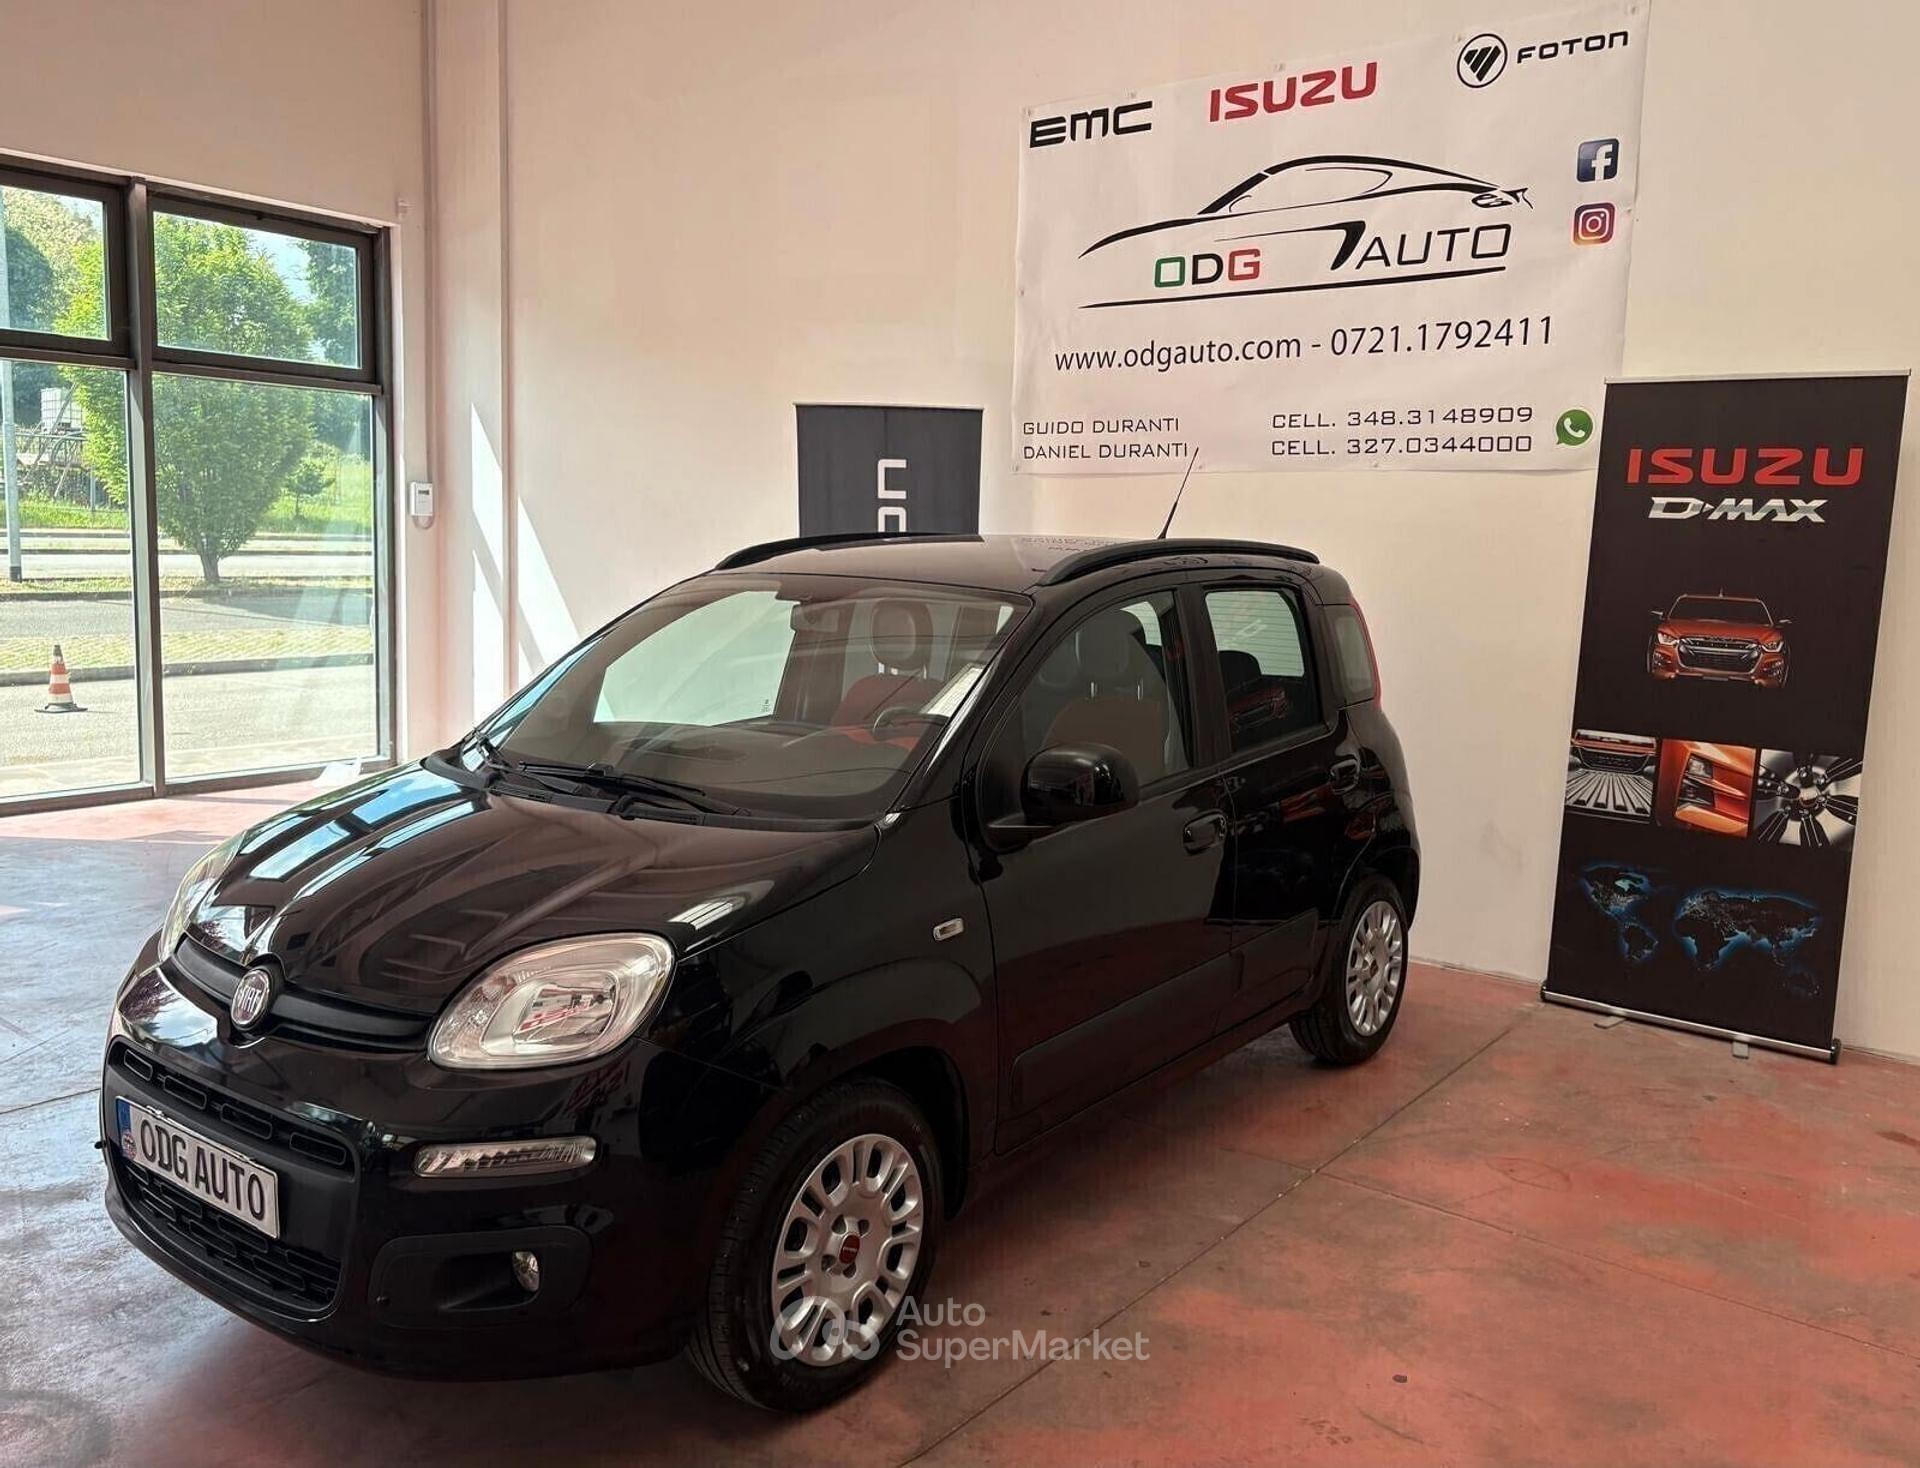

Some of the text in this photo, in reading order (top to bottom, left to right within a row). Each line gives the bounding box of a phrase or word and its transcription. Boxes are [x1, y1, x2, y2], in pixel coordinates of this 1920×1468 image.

[1517, 31, 1629, 63] FOTON
[1209, 62, 1378, 122] ISUZU
[1029, 100, 1153, 148] EMC
[1154, 223, 1512, 288] ODG AUTO
[1054, 336, 1301, 373] www.odgauto.com
[1331, 316, 1552, 356] 0721.1792411
[1023, 417, 1180, 435] GUIDO DURANTI
[1272, 406, 1533, 429] CELL. 348.3148909
[1024, 443, 1188, 459] DANIEL DURANTI
[1271, 434, 1533, 456] CELL. 327.0344000
[1627, 448, 1864, 485] ISUZU
[238, 984, 262, 1013] FIAT
[140, 1119, 265, 1221] ODG AUTO
